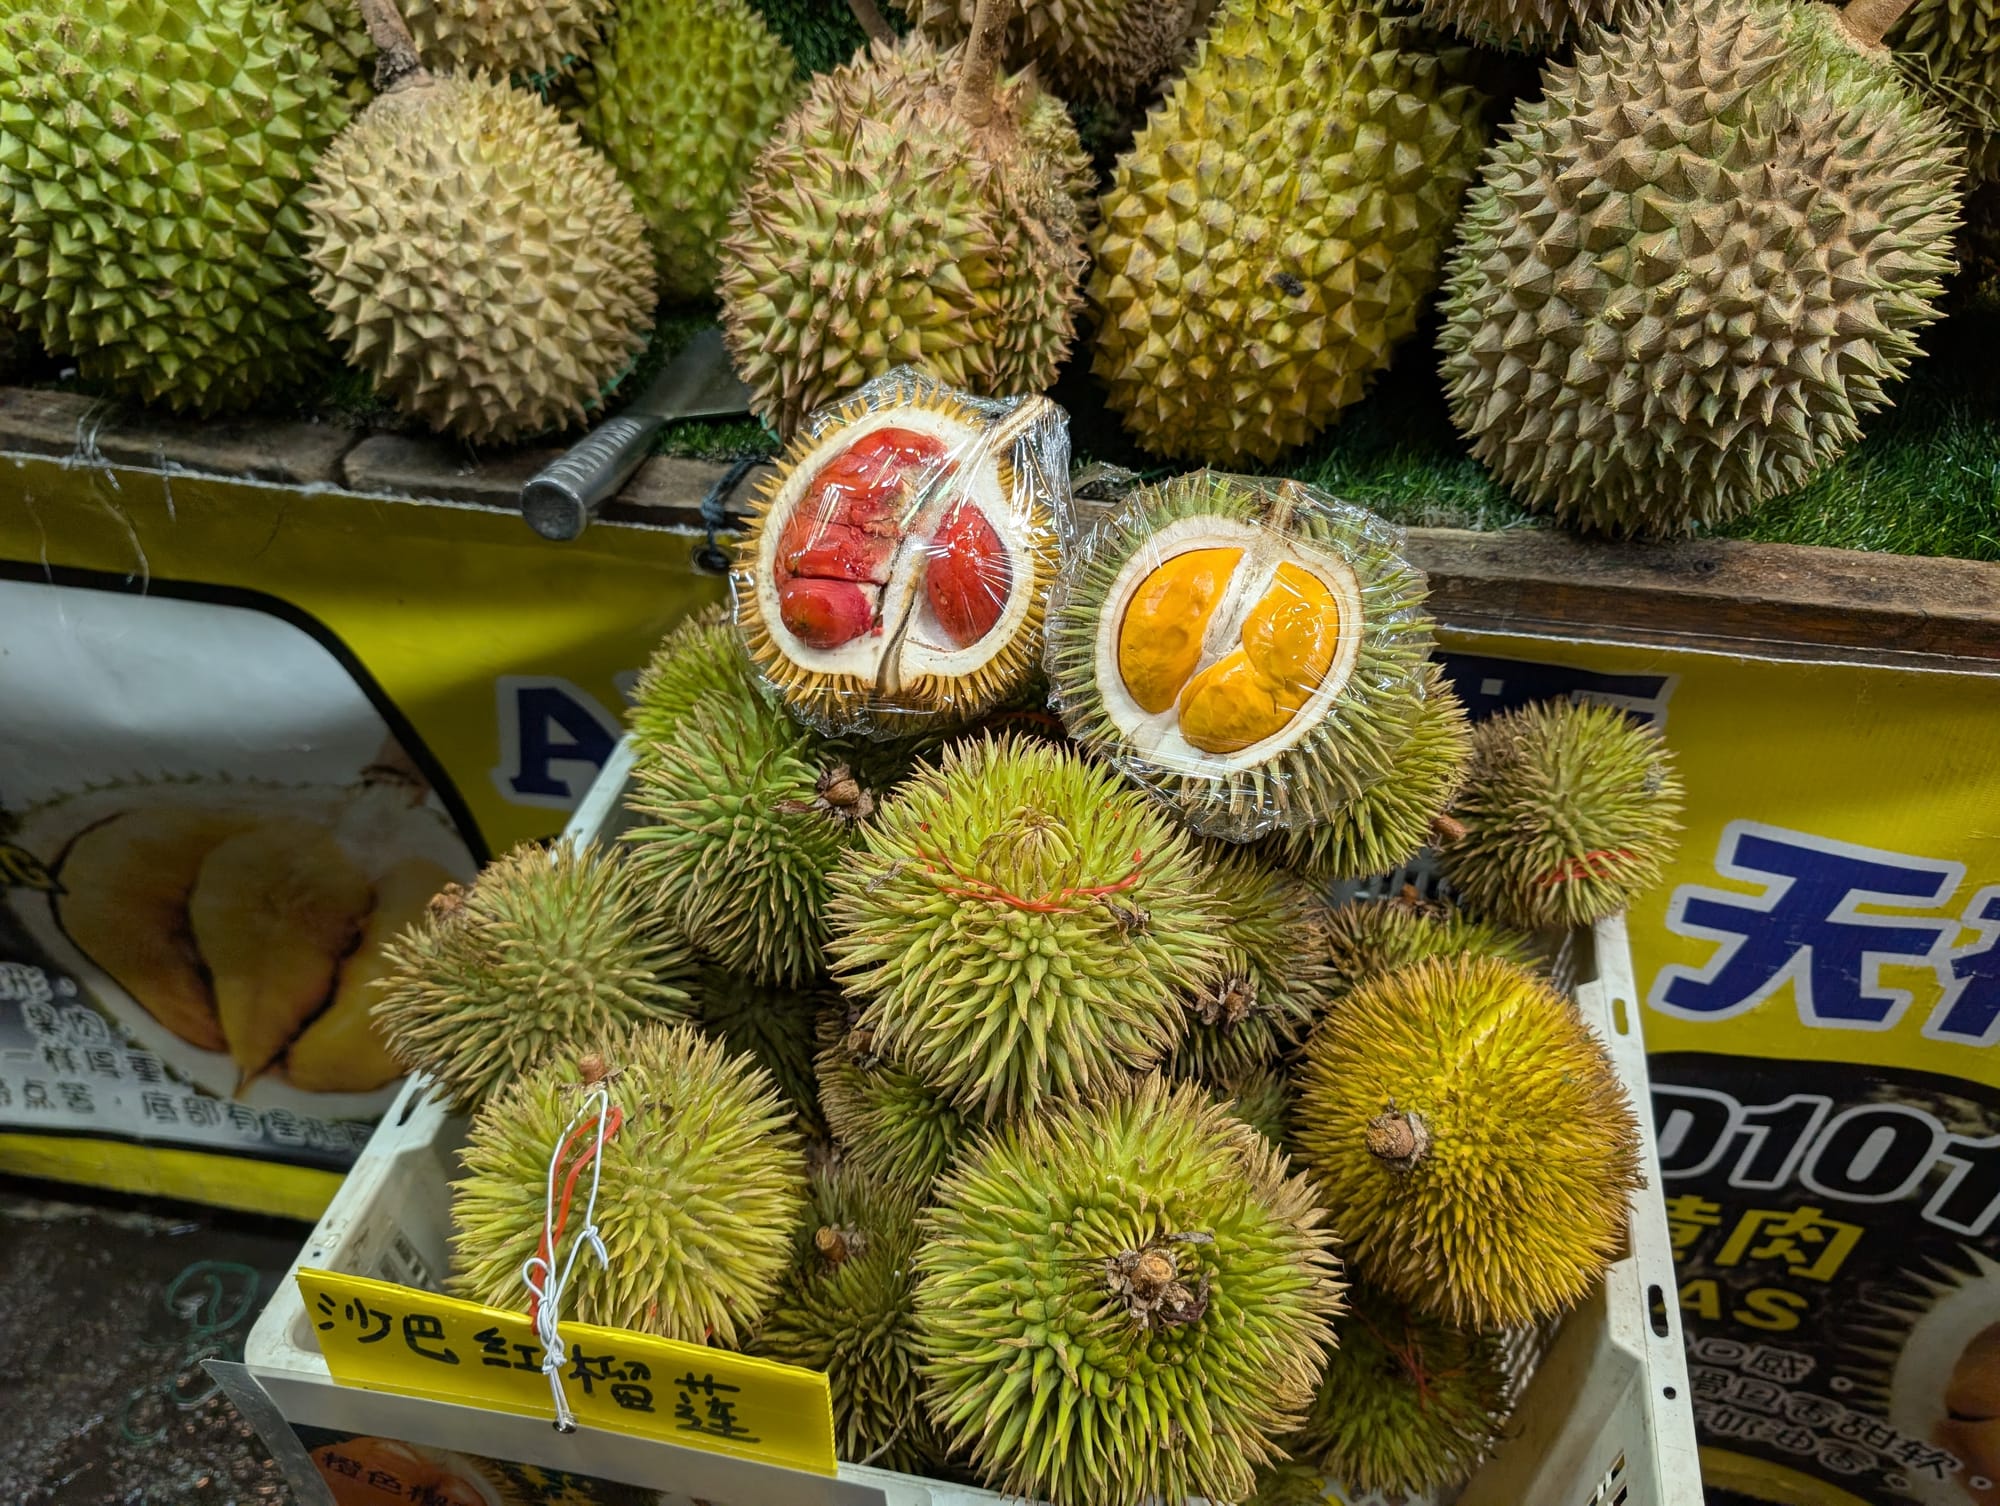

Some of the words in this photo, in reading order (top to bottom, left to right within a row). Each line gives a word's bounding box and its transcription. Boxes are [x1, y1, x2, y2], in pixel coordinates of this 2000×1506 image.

[317, 1291, 763, 1444] 沙巴红榴莲
